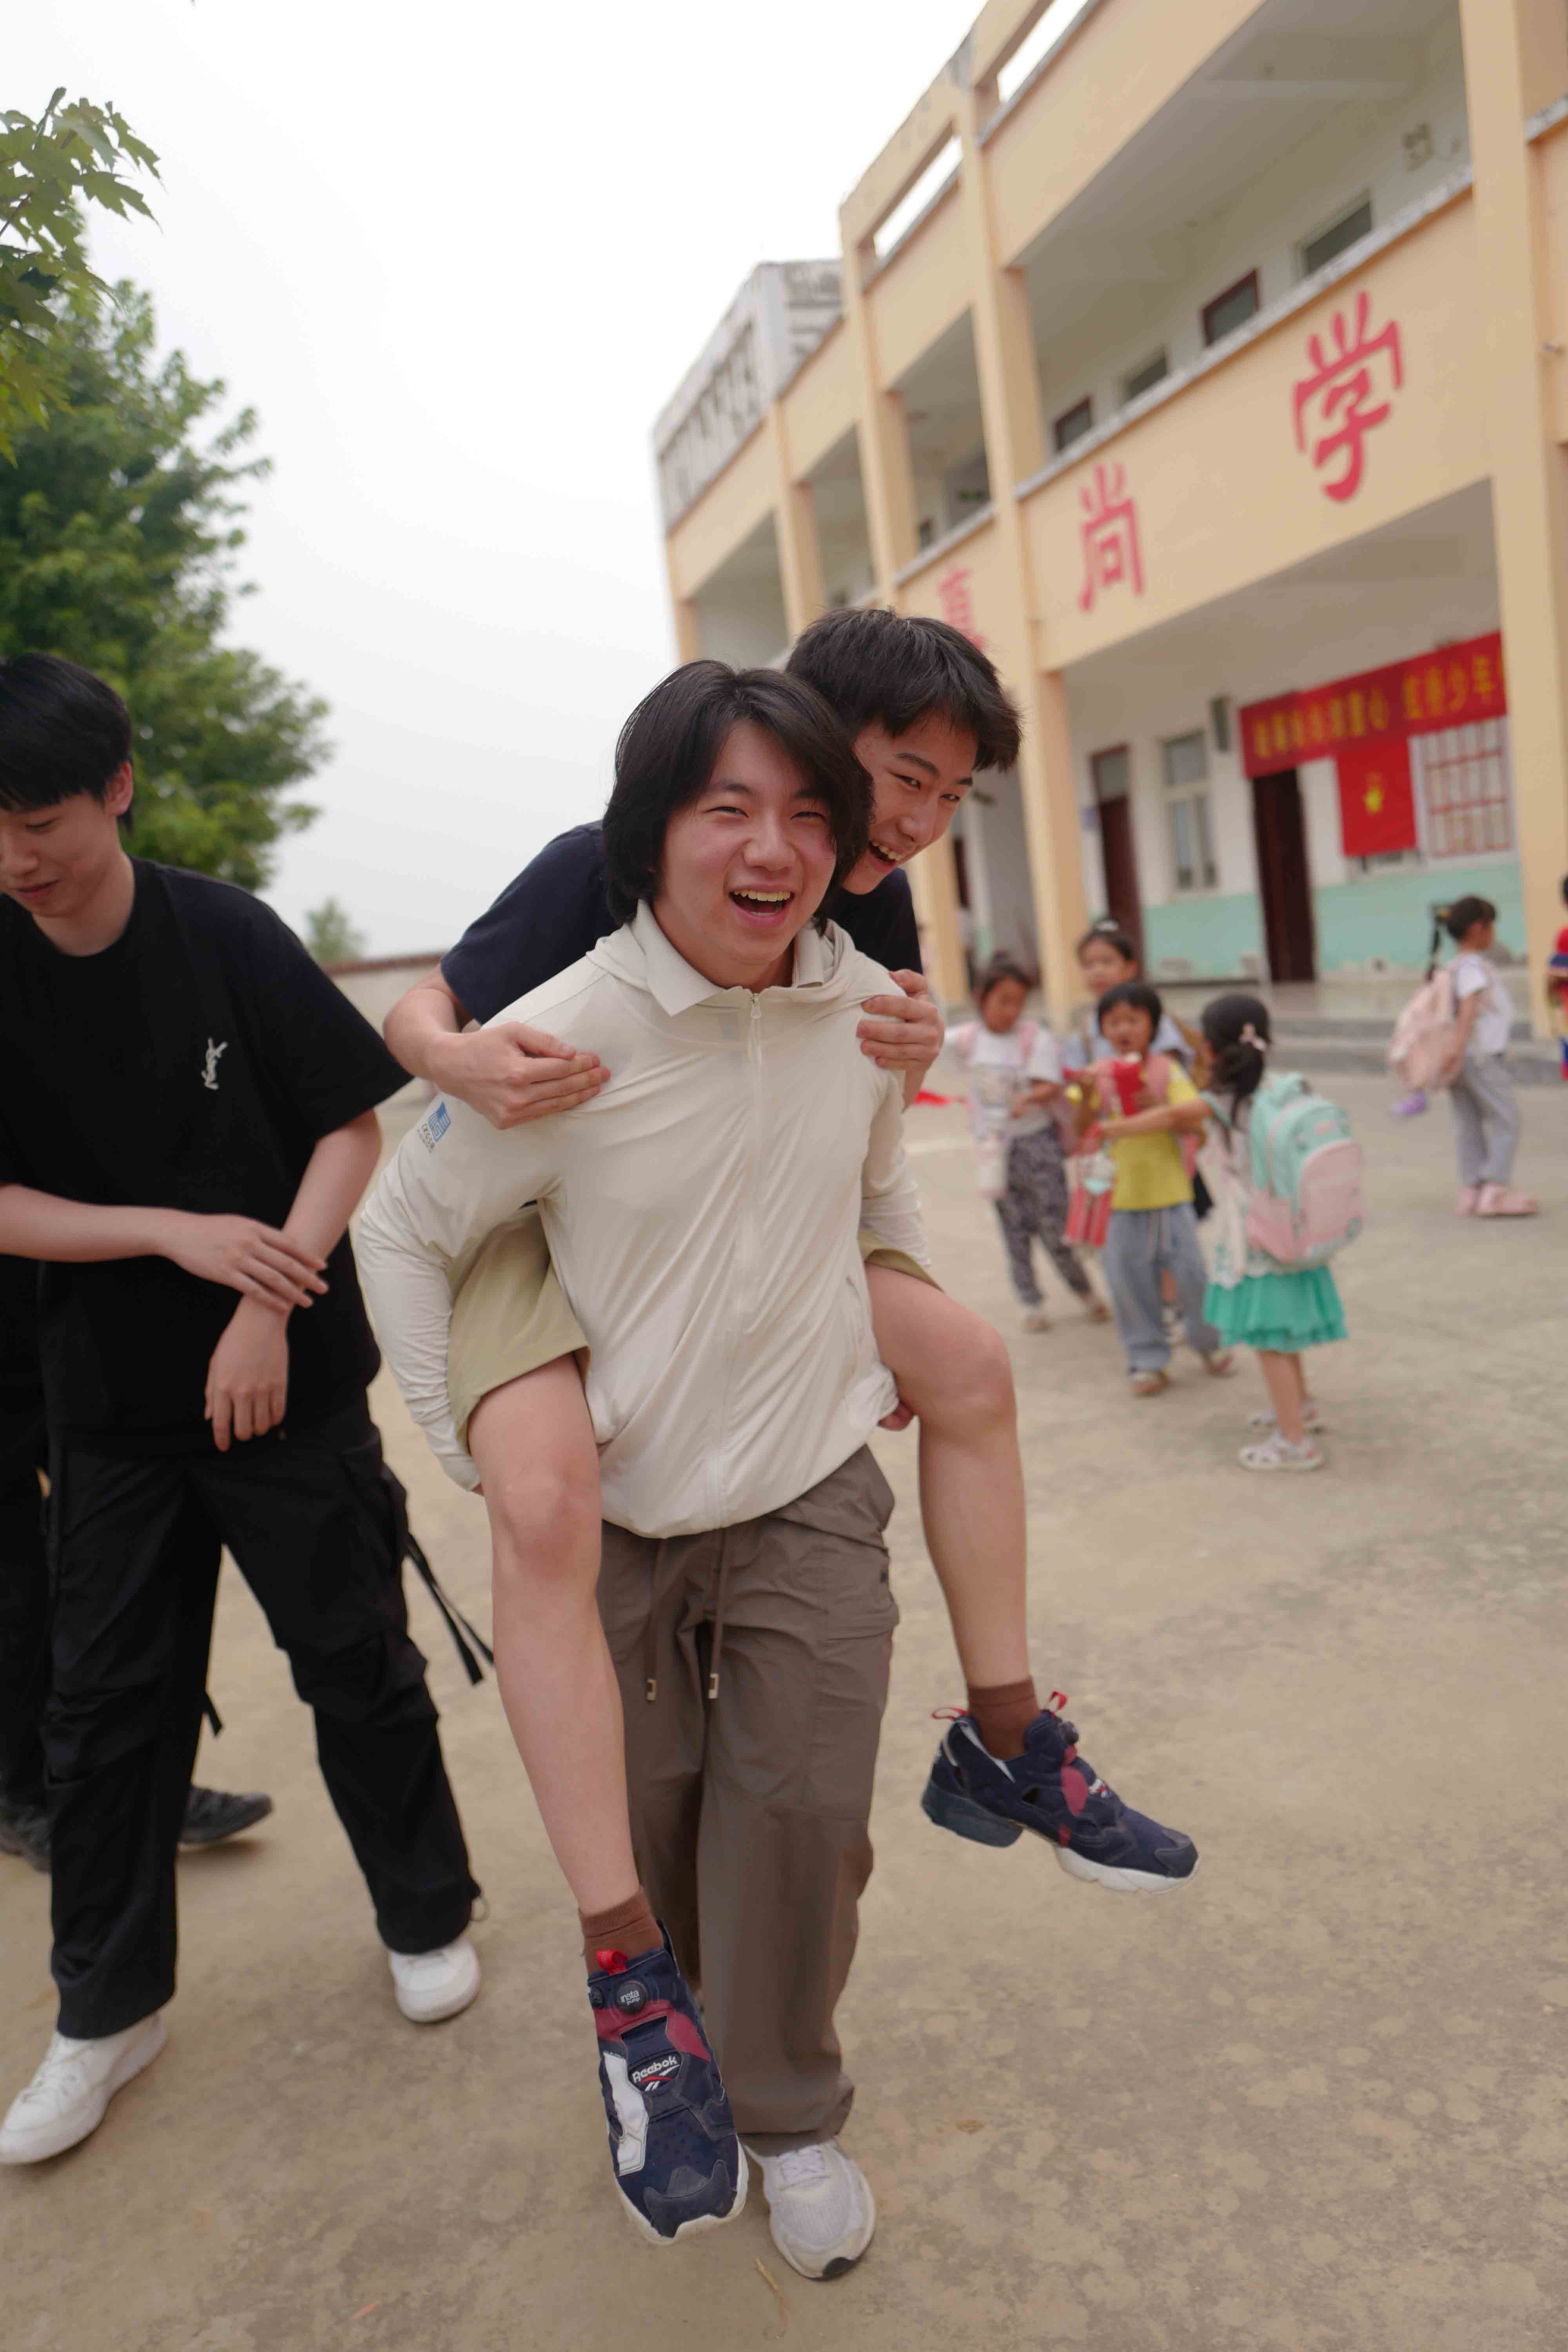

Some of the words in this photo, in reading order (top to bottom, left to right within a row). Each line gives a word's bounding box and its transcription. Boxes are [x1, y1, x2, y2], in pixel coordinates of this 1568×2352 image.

[1078, 461, 1146, 612] 尚
[1292, 291, 1403, 502] 学
[621, 1990, 640, 2003] insta
[632, 2055, 677, 2083] Reebok
